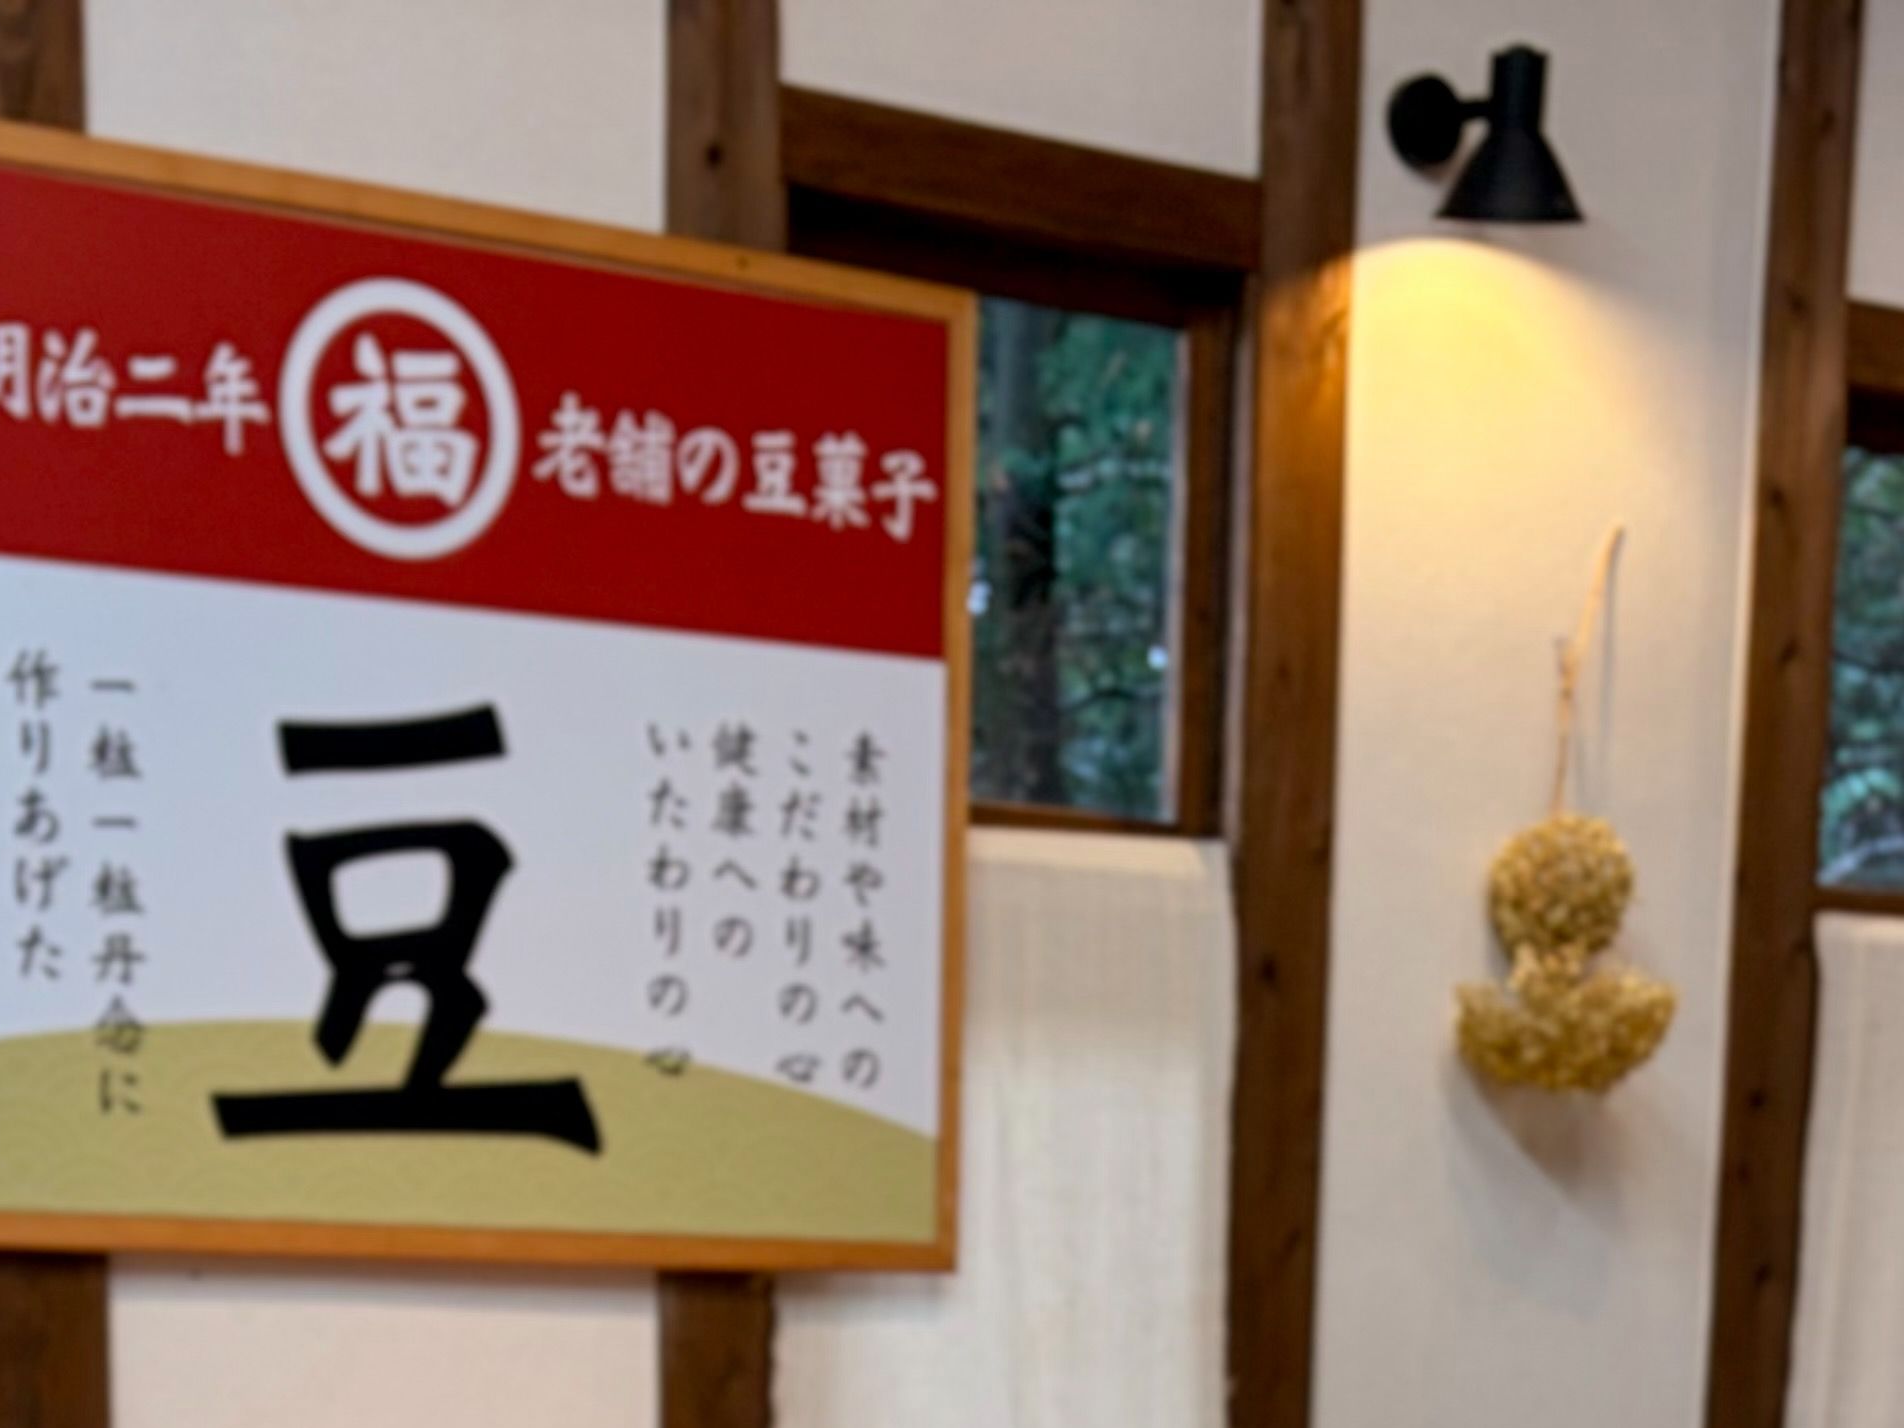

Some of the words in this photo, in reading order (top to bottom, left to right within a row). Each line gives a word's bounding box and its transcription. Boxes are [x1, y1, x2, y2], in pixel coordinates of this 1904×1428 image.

[328, 332, 480, 507] 福
[532, 393, 937, 541] 老舗の豆菓子
[7, 649, 69, 982] 作りあげた
[90, 682, 146, 1116] 一粒一粒丹念に
[209, 700, 603, 1157] 豆
[646, 720, 691, 1081] いたわりの心
[714, 720, 757, 959] 健康への
[776, 733, 821, 1084] こだわりの心
[842, 733, 886, 1090] 素材や味への
